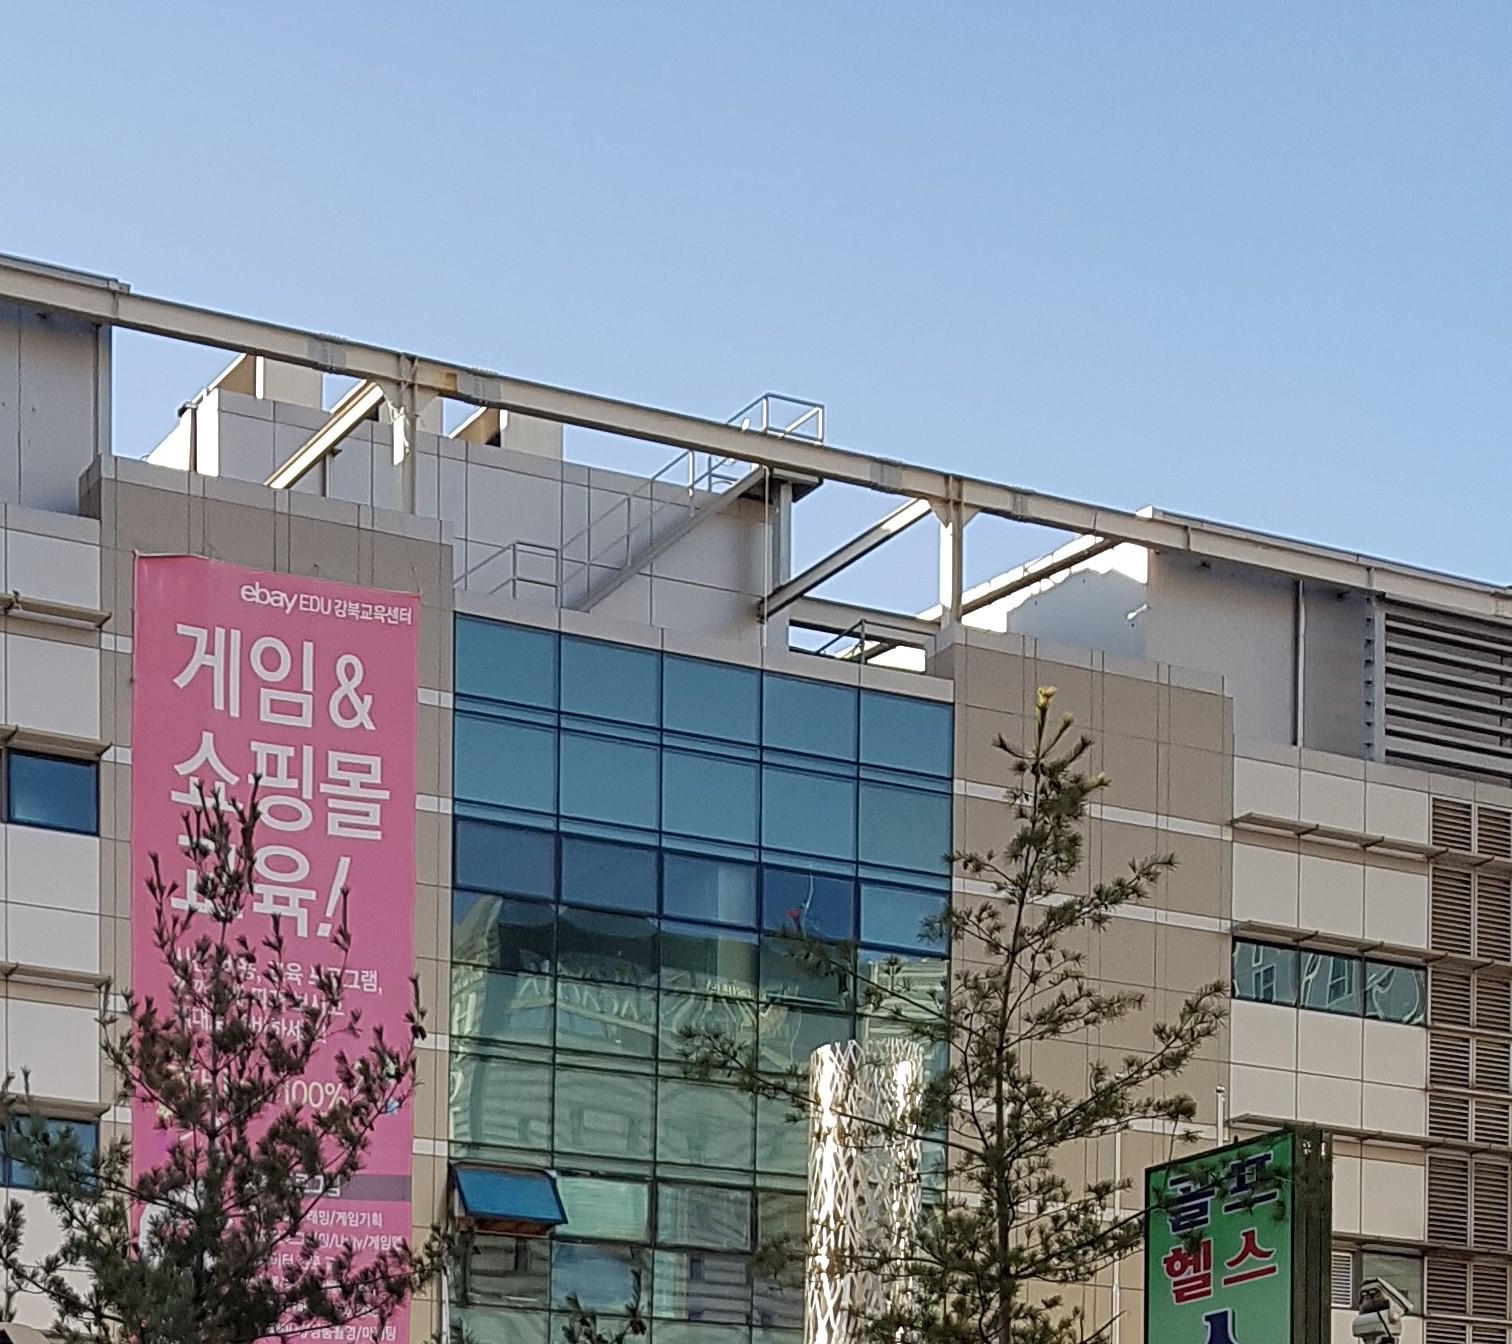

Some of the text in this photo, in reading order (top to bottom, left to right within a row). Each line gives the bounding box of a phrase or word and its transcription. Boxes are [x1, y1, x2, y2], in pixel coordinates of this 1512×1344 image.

[240, 582, 413, 625] ebay EDU 강북교육센터
[171, 730, 390, 841] 쇼핑몰
[1168, 1151, 1280, 1235] 골프
[1162, 1227, 1278, 1305] 헬스
